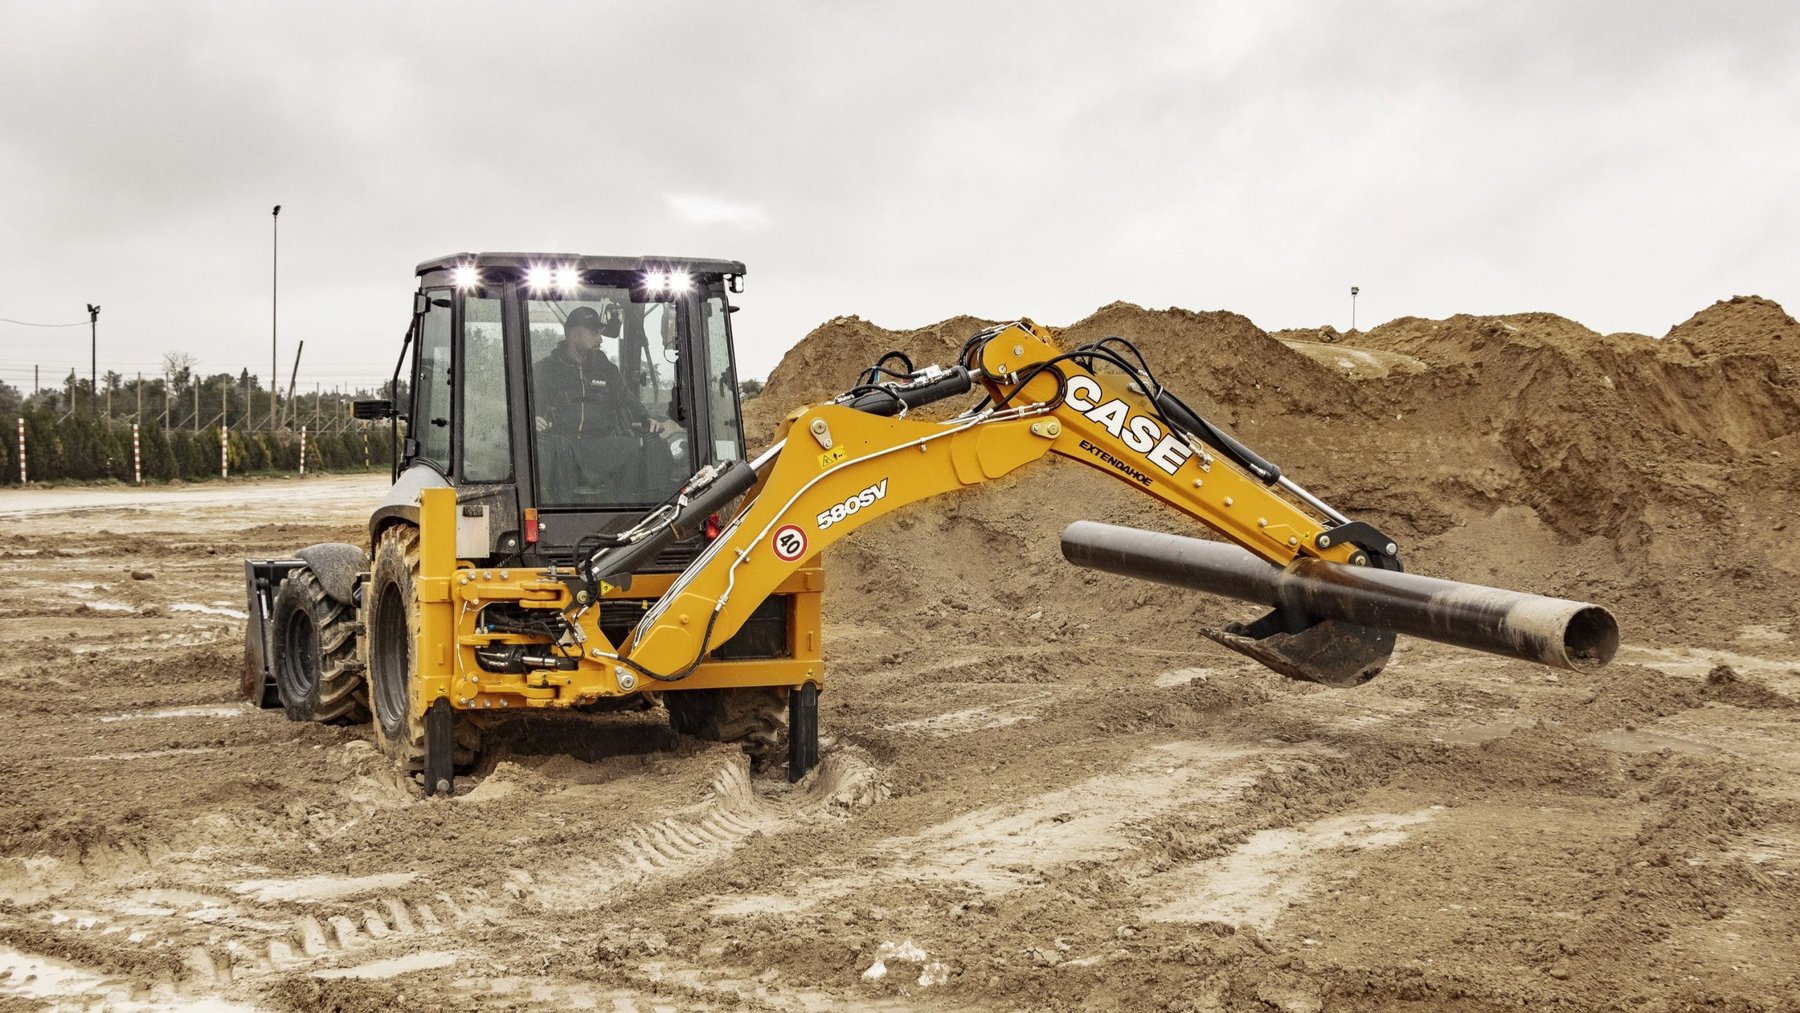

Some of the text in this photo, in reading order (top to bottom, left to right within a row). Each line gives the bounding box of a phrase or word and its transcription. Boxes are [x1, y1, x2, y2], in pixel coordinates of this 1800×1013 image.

[1065, 375, 1194, 475] CASE
[1079, 440, 1153, 486] EXTENDAHOE
[816, 477, 888, 530] 580SV
[780, 533, 801, 554] 40
